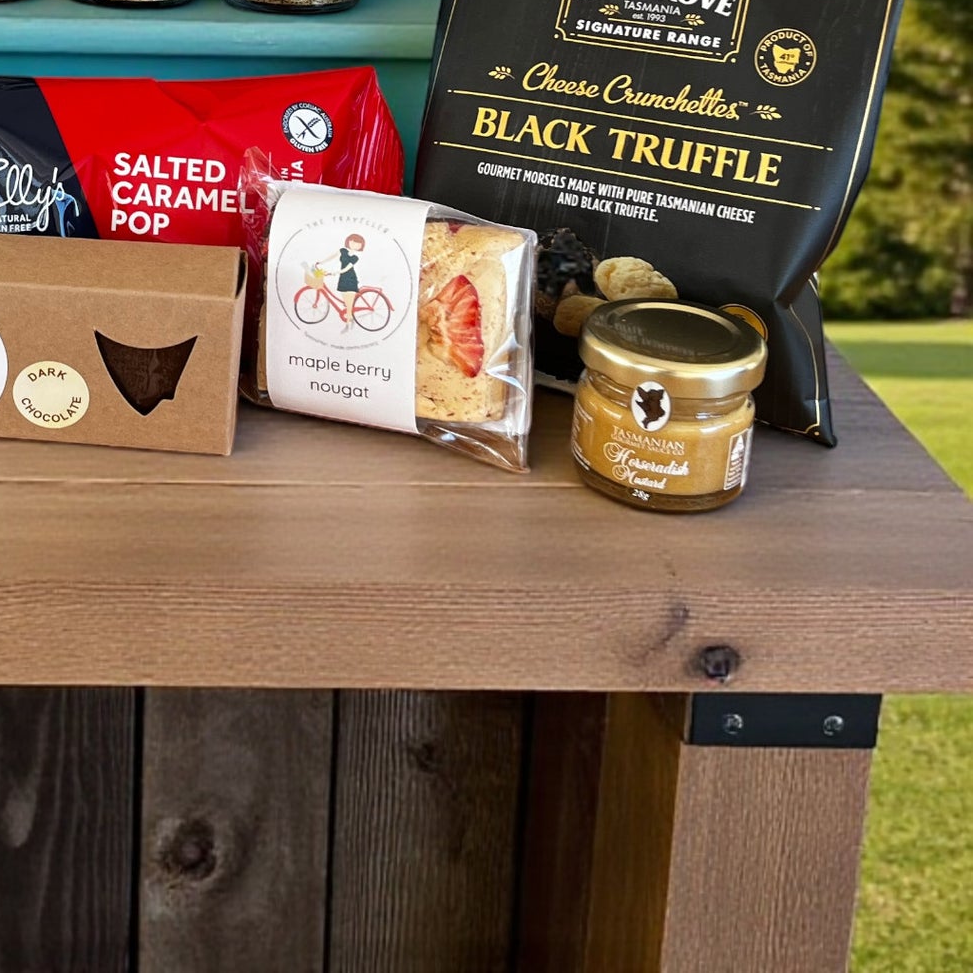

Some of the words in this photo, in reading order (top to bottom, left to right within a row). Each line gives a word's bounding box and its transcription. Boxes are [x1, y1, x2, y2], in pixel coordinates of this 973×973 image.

[623, 0, 681, 15] TASMANIA
[632, 13, 644, 21] est.
[647, 12, 667, 23] 1993
[575, 19, 661, 41] SIGNATURE
[667, 31, 721, 48] RANGE
[760, 31, 807, 52] PRODUCT
[803, 43, 813, 57] OF
[760, 63, 807, 83] TASMANIA
[522, 62, 601, 98] Cheese
[603, 74, 740, 120] Crunchettes
[289, 138, 315, 153] GLUTEN
[315, 141, 329, 152] FREE
[472, 106, 597, 155] BLACK
[608, 128, 783, 187] TRUFFLE
[113, 151, 226, 183] SALTED
[112, 181, 255, 215] CARAMEL
[477, 161, 523, 180] GOURMET
[523, 170, 567, 189] MORSELS
[567, 179, 597, 195] MADE
[597, 183, 625, 199] WITH
[625, 188, 655, 205] PURE
[655, 193, 715, 217] TASMANIAN
[716, 205, 756, 224] CHEESE
[557, 191, 579, 207] AND
[581, 195, 613, 214] BLACK
[614, 201, 659, 223] TRUFFLE.
[9, 224, 32, 232] FREE
[111, 209, 170, 235] POP
[27, 367, 67, 382] DARK
[289, 354, 340, 372] maple
[345, 359, 391, 381] berry
[310, 380, 369, 399] nougat
[21, 396, 82, 423] CHOCOLATE
[613, 425, 685, 450] TASMANIAN
[603, 442, 689, 475] Horseradish
[612, 465, 667, 489] Mustard
